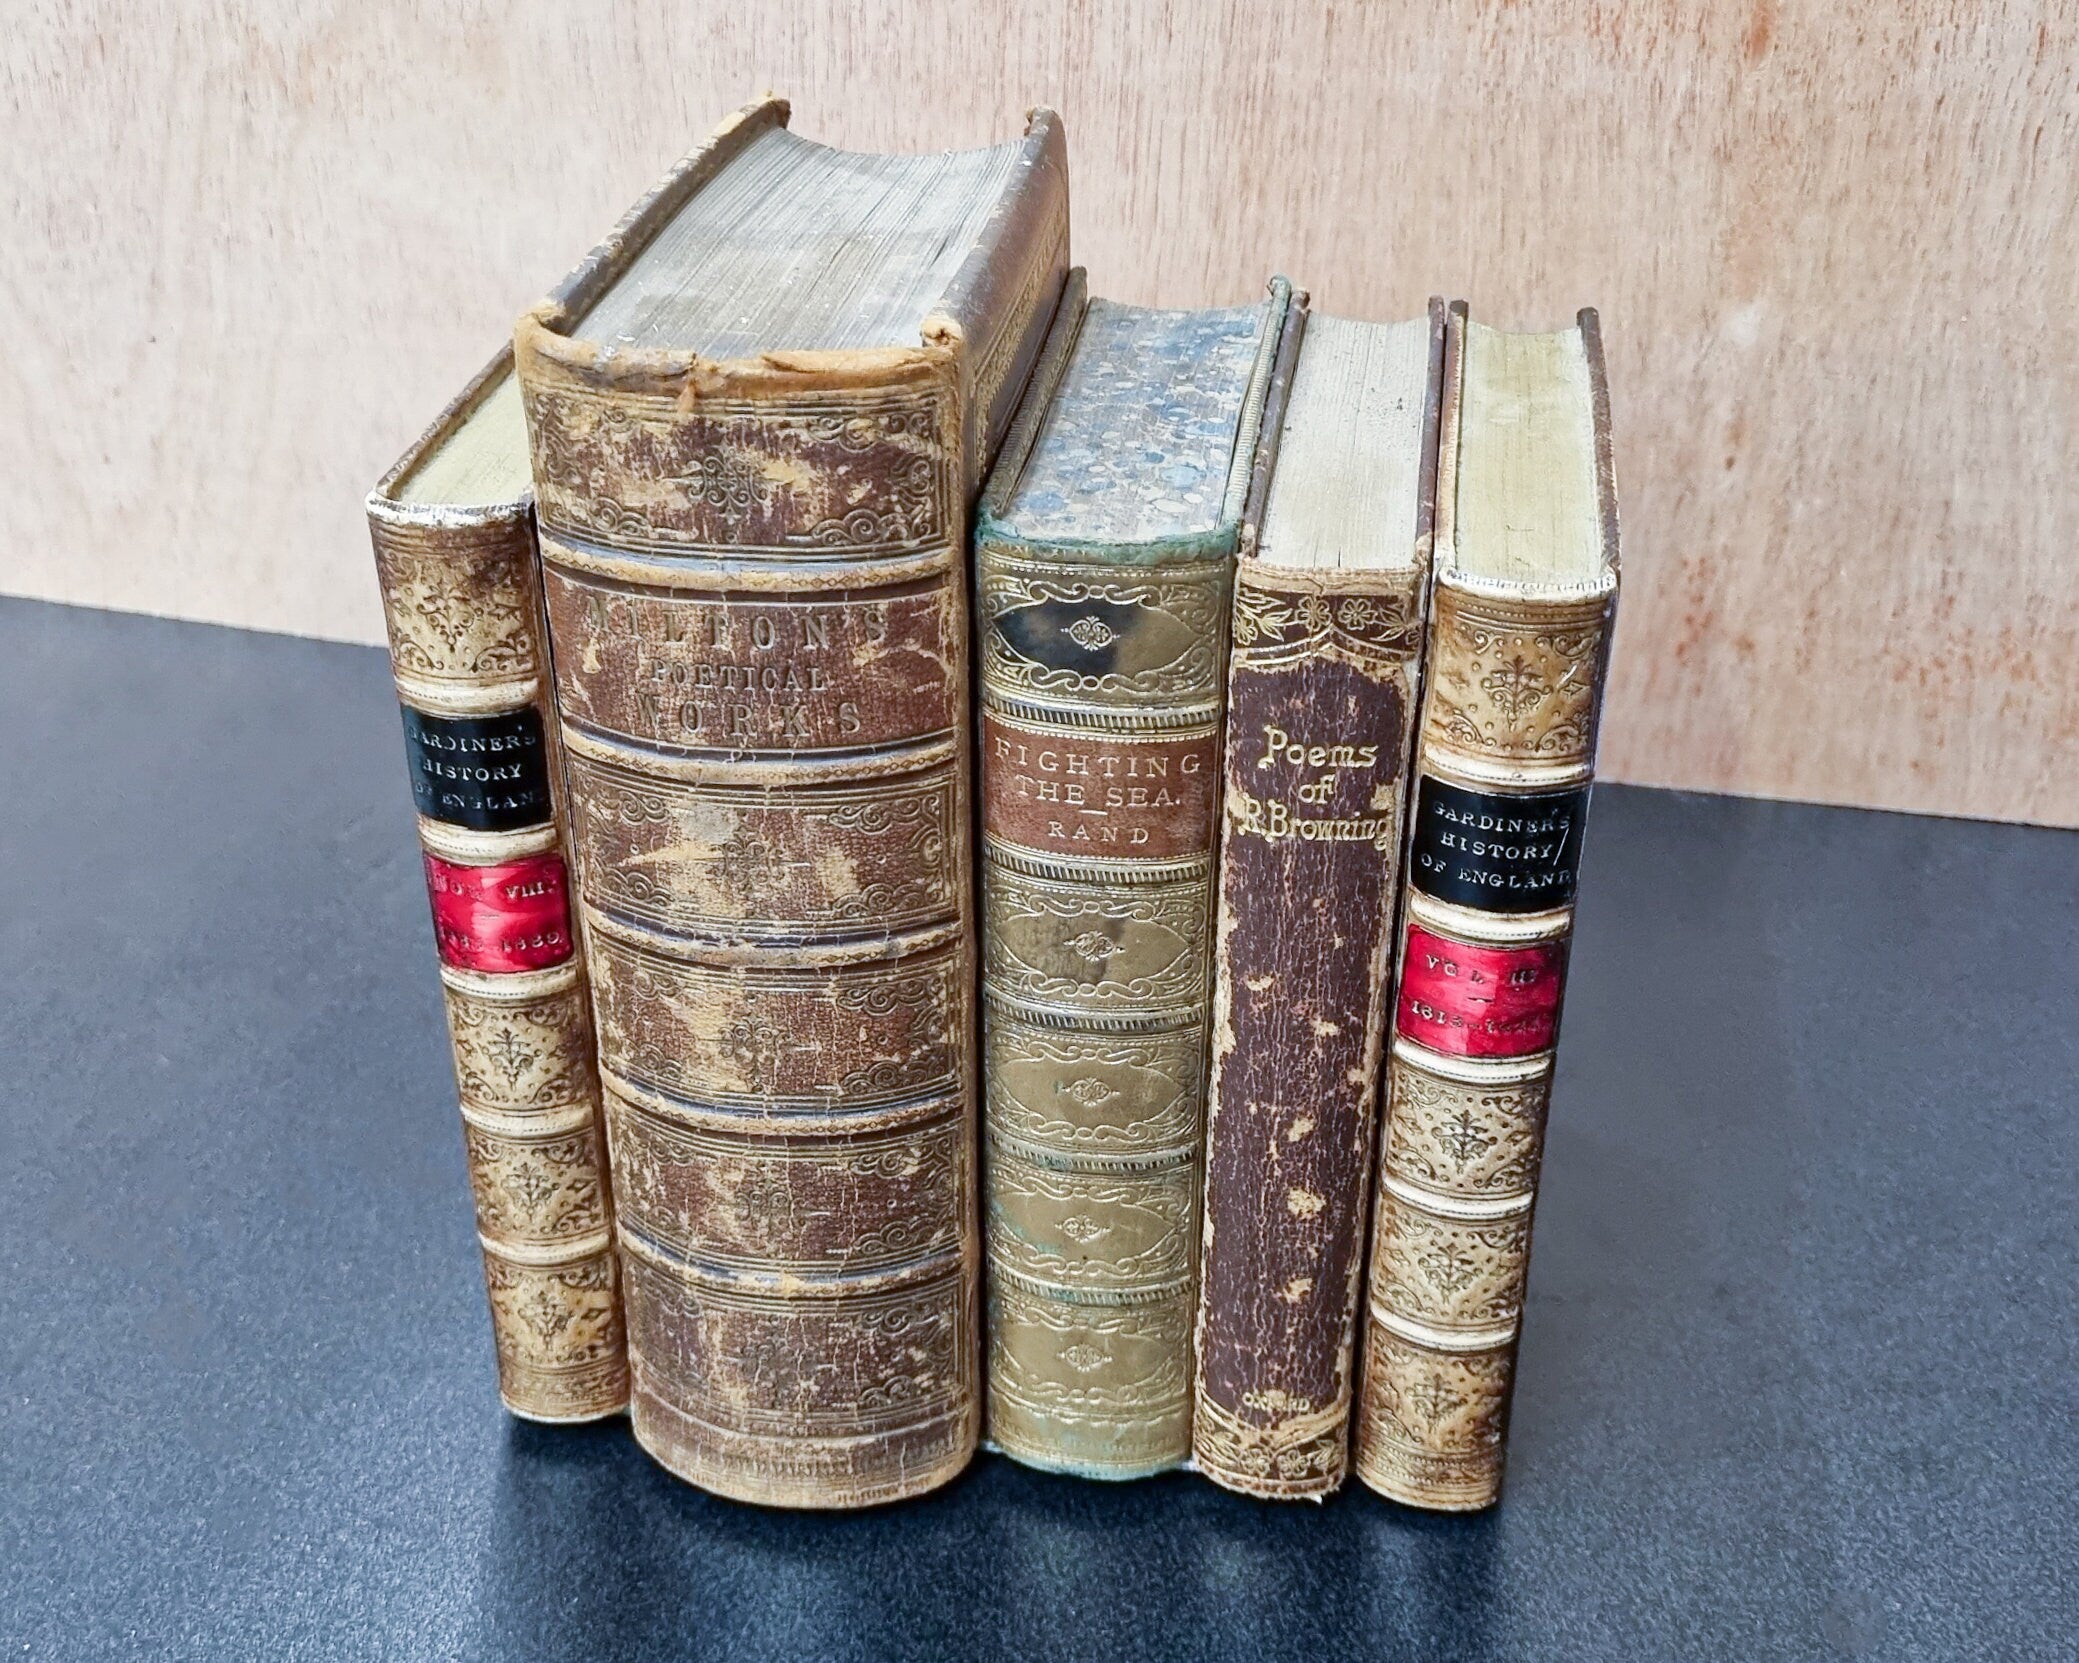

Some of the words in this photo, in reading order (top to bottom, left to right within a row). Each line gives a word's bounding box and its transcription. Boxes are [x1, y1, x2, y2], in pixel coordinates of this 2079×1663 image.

[651, 660, 828, 692] POETICAL
[639, 692, 861, 738] WORKS
[994, 737, 1201, 778] FIGHTING
[1258, 725, 1379, 769] Poems
[423, 758, 522, 782] HISTORY
[442, 790, 546, 811] ENGLAN
[1015, 774, 1086, 806] THE
[1105, 787, 1182, 808] SEA.
[1299, 774, 1337, 804] of
[1048, 820, 1150, 845] RAND
[1440, 831, 1553, 861] HISTORY
[1420, 853, 1448, 874] OF
[1457, 867, 1572, 889] ENGLAND
